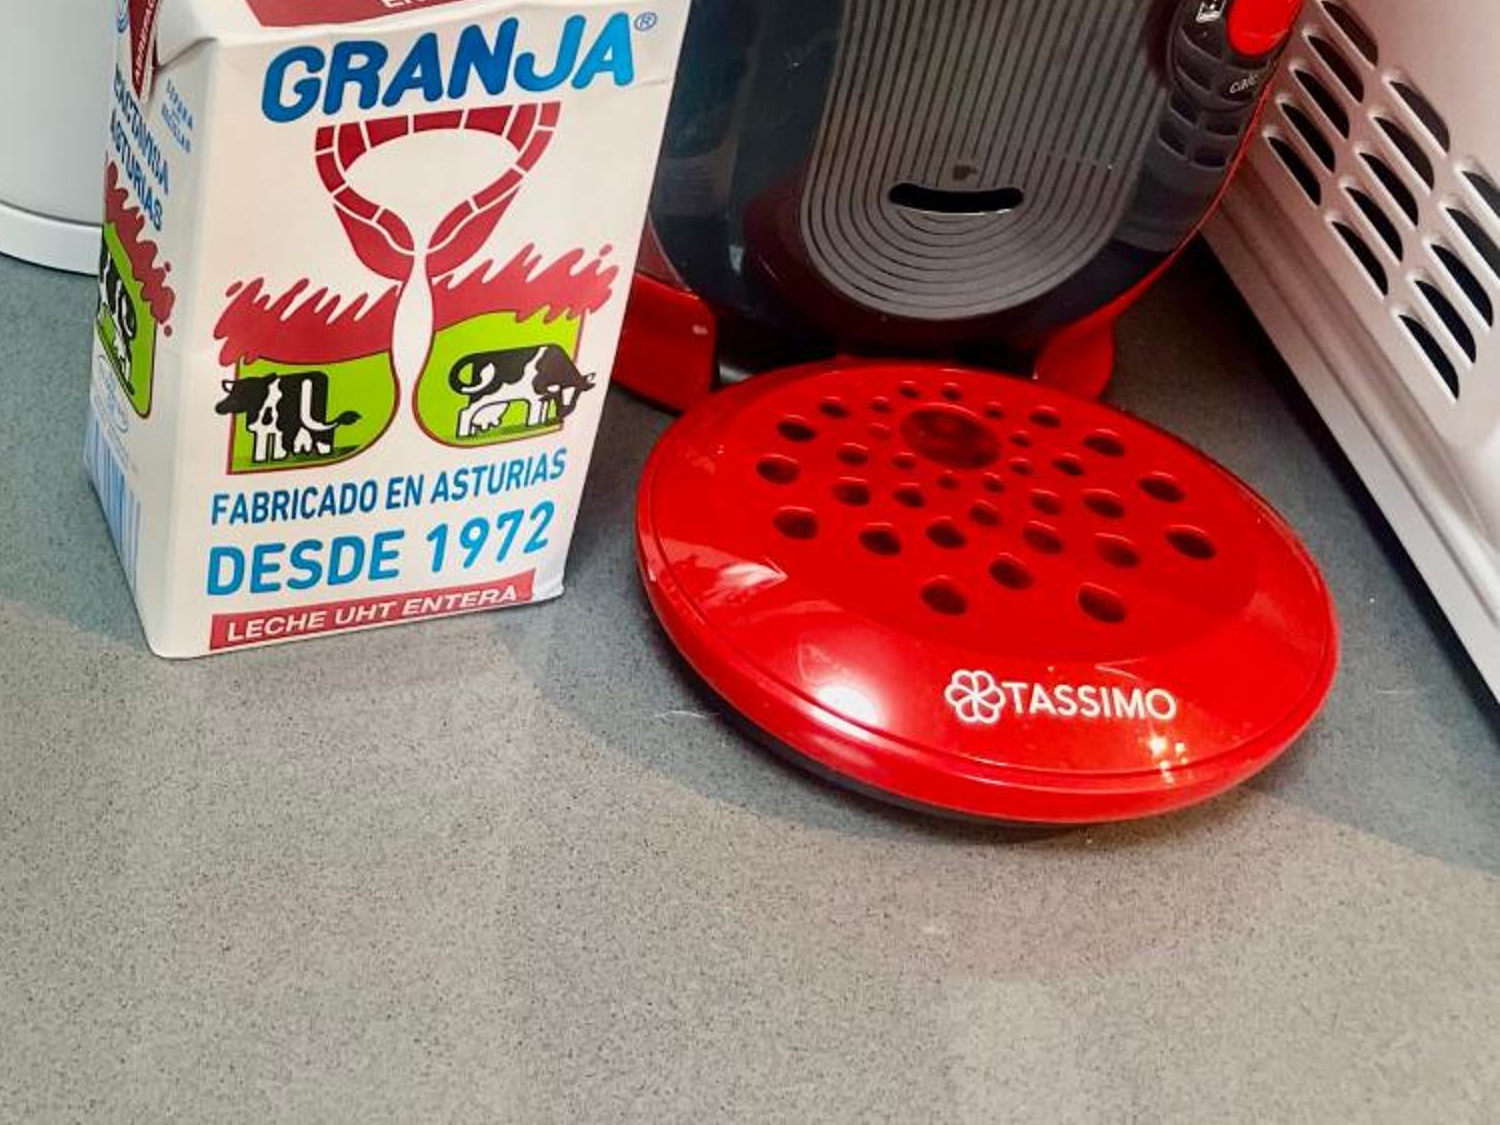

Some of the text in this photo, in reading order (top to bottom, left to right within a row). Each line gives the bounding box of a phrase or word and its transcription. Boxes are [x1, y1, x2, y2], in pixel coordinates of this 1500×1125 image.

[261, 11, 636, 124] GRANJA
[210, 447, 569, 526] FABRICADO EN ASTURIAS
[206, 499, 557, 597] DESDE 1972
[226, 583, 519, 643] LECHE UHT ENTERA
[1001, 681, 1179, 721] TASSIMO
